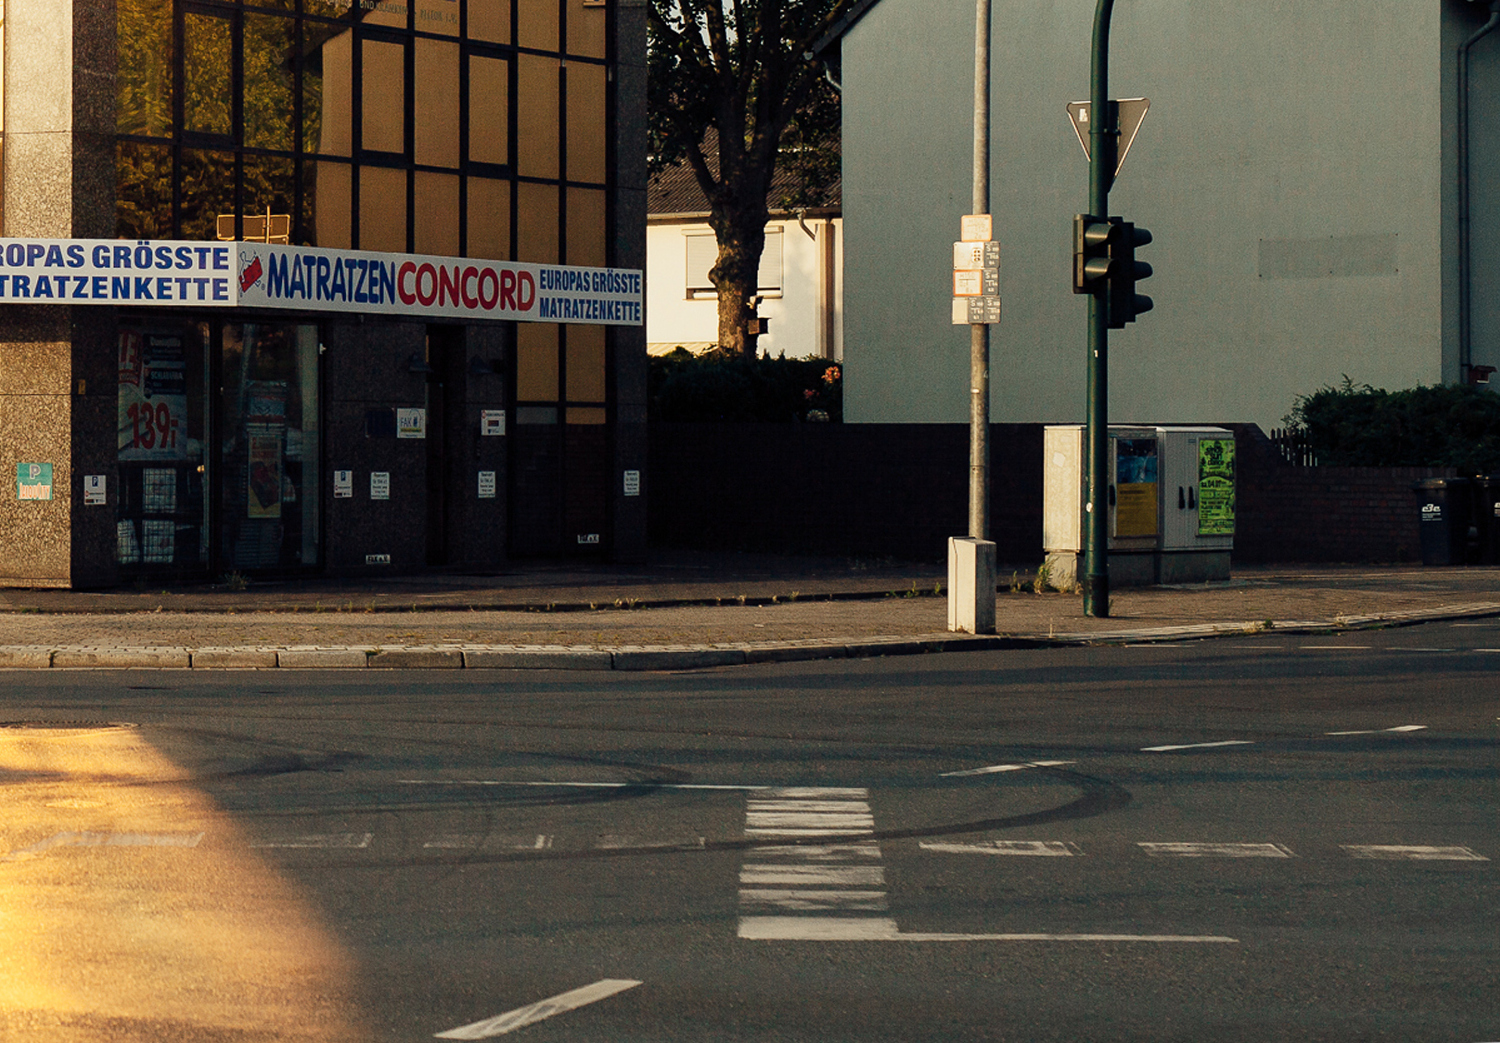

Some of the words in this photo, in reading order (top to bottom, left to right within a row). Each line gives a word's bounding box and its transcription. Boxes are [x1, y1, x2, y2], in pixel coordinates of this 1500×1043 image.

[92, 240, 229, 271] GRÖSSTE
[267, 253, 396, 305] MATRATZEN
[397, 261, 536, 312] CONCORD
[539, 268, 591, 293] EUROPAS
[592, 268, 641, 294] GRÖSSTE
[539, 298, 641, 322] MATRATZENKETTE
[29, 464, 42, 481] P
